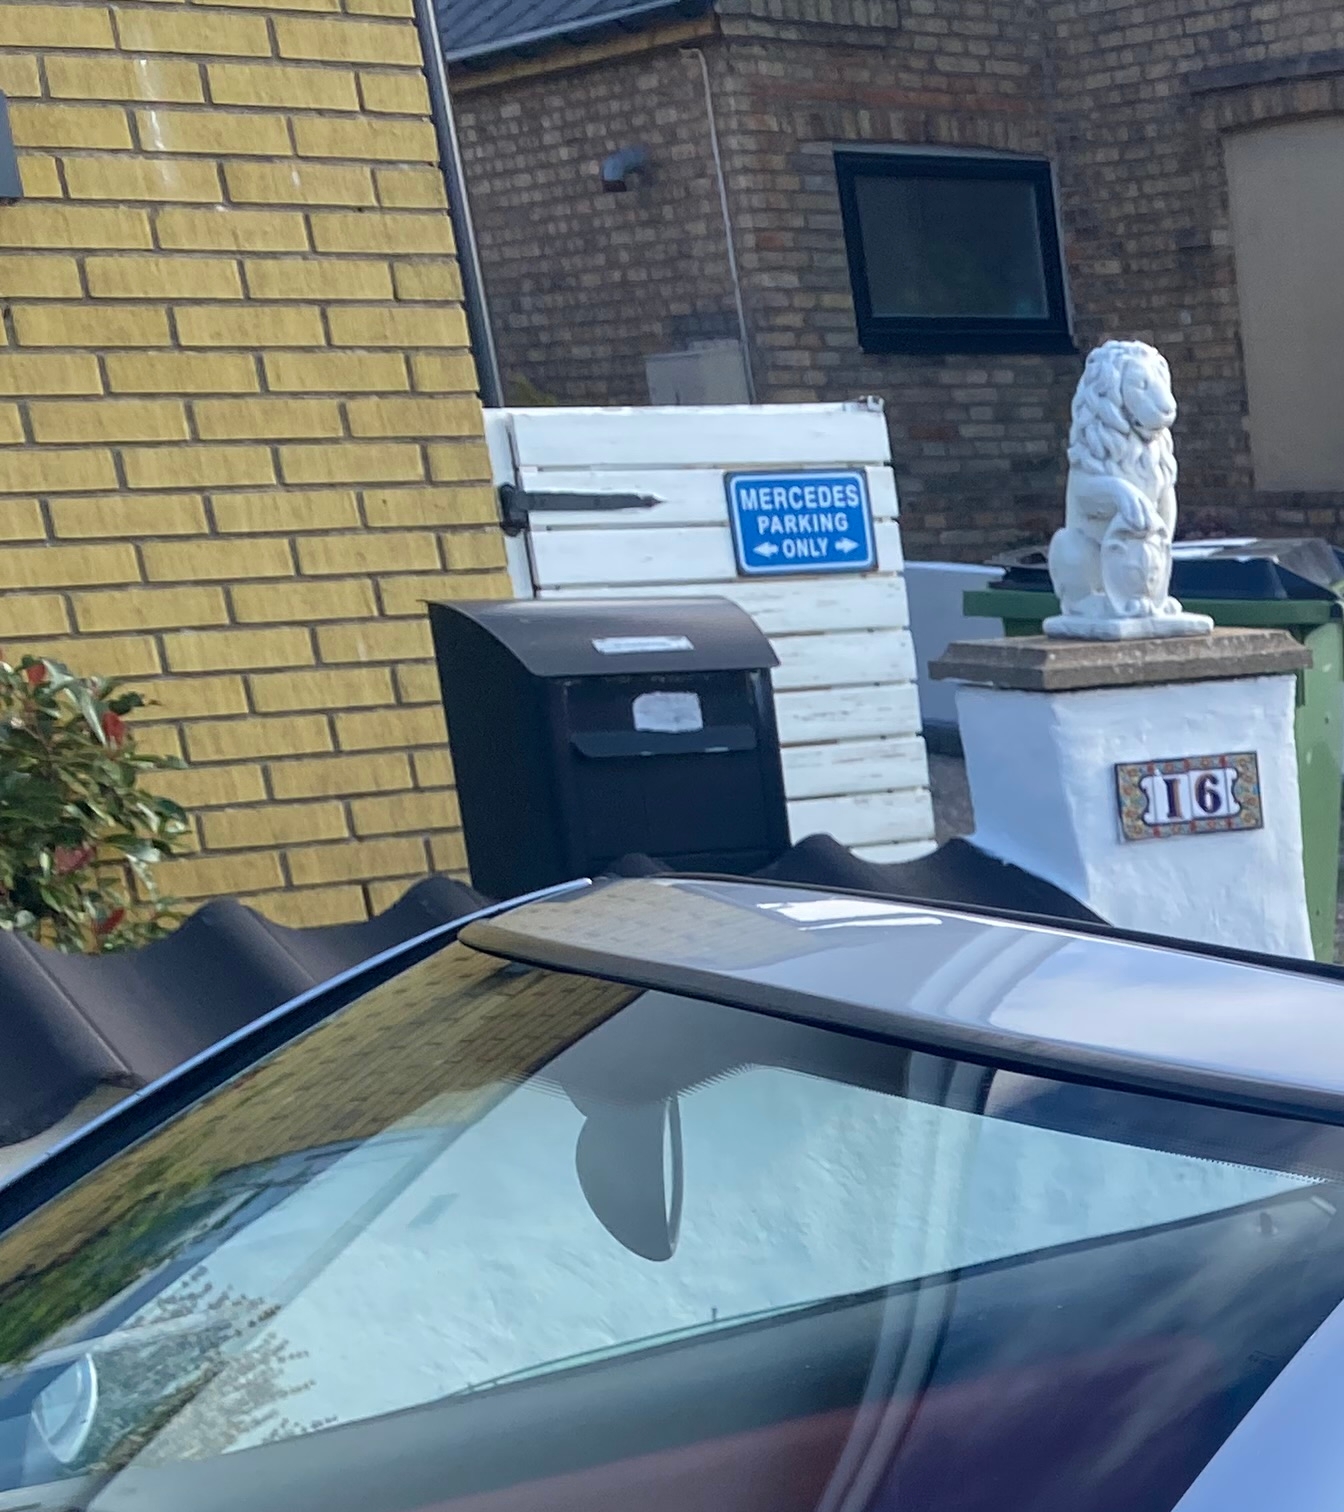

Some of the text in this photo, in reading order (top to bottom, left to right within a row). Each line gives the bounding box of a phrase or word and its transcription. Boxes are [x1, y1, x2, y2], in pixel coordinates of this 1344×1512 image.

[739, 484, 860, 511] MERCEDES
[757, 512, 849, 535] PARKING
[782, 537, 829, 559] ONLY
[1162, 773, 1223, 820] 16
